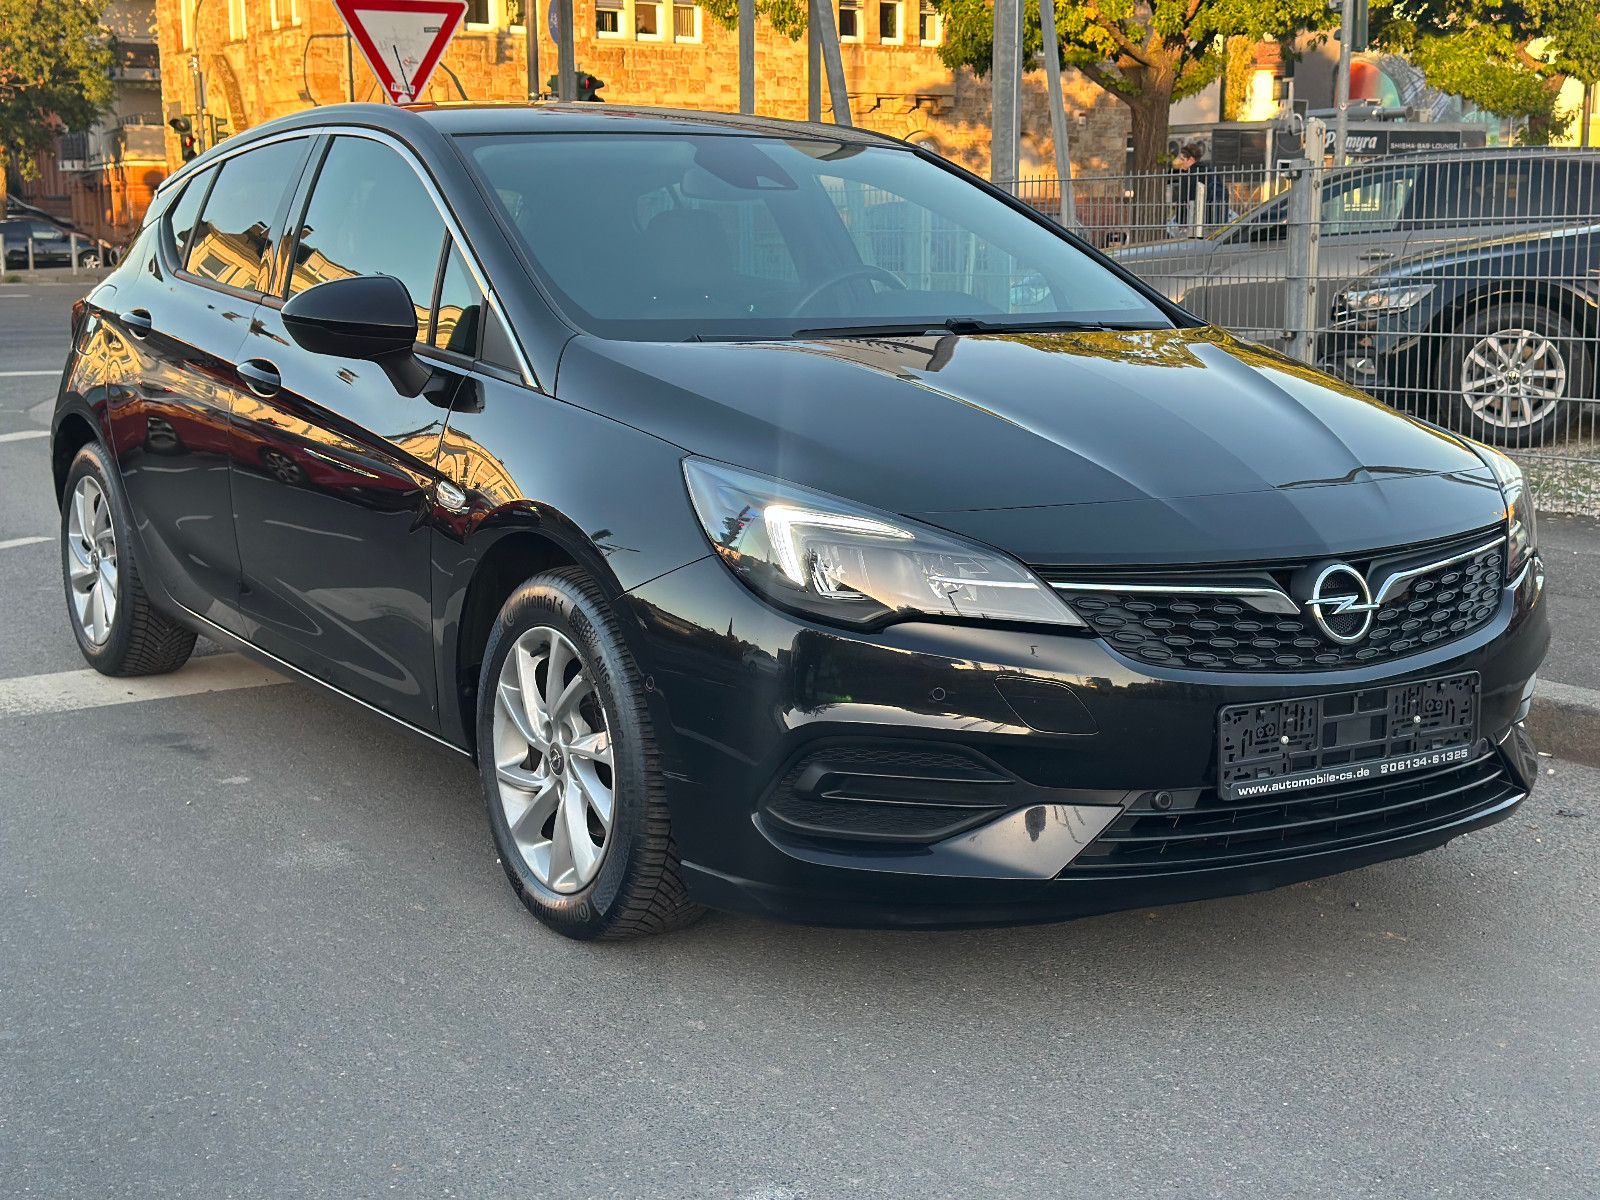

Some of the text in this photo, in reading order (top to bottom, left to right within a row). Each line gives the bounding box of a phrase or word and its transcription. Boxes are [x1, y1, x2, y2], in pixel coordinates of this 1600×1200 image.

[1325, 131, 1377, 152] Pmyra
[1390, 142, 1415, 150] SHISHA
[1432, 142, 1458, 150] LOUNGE
[1238, 767, 1370, 796] www.automobile-cs.de
